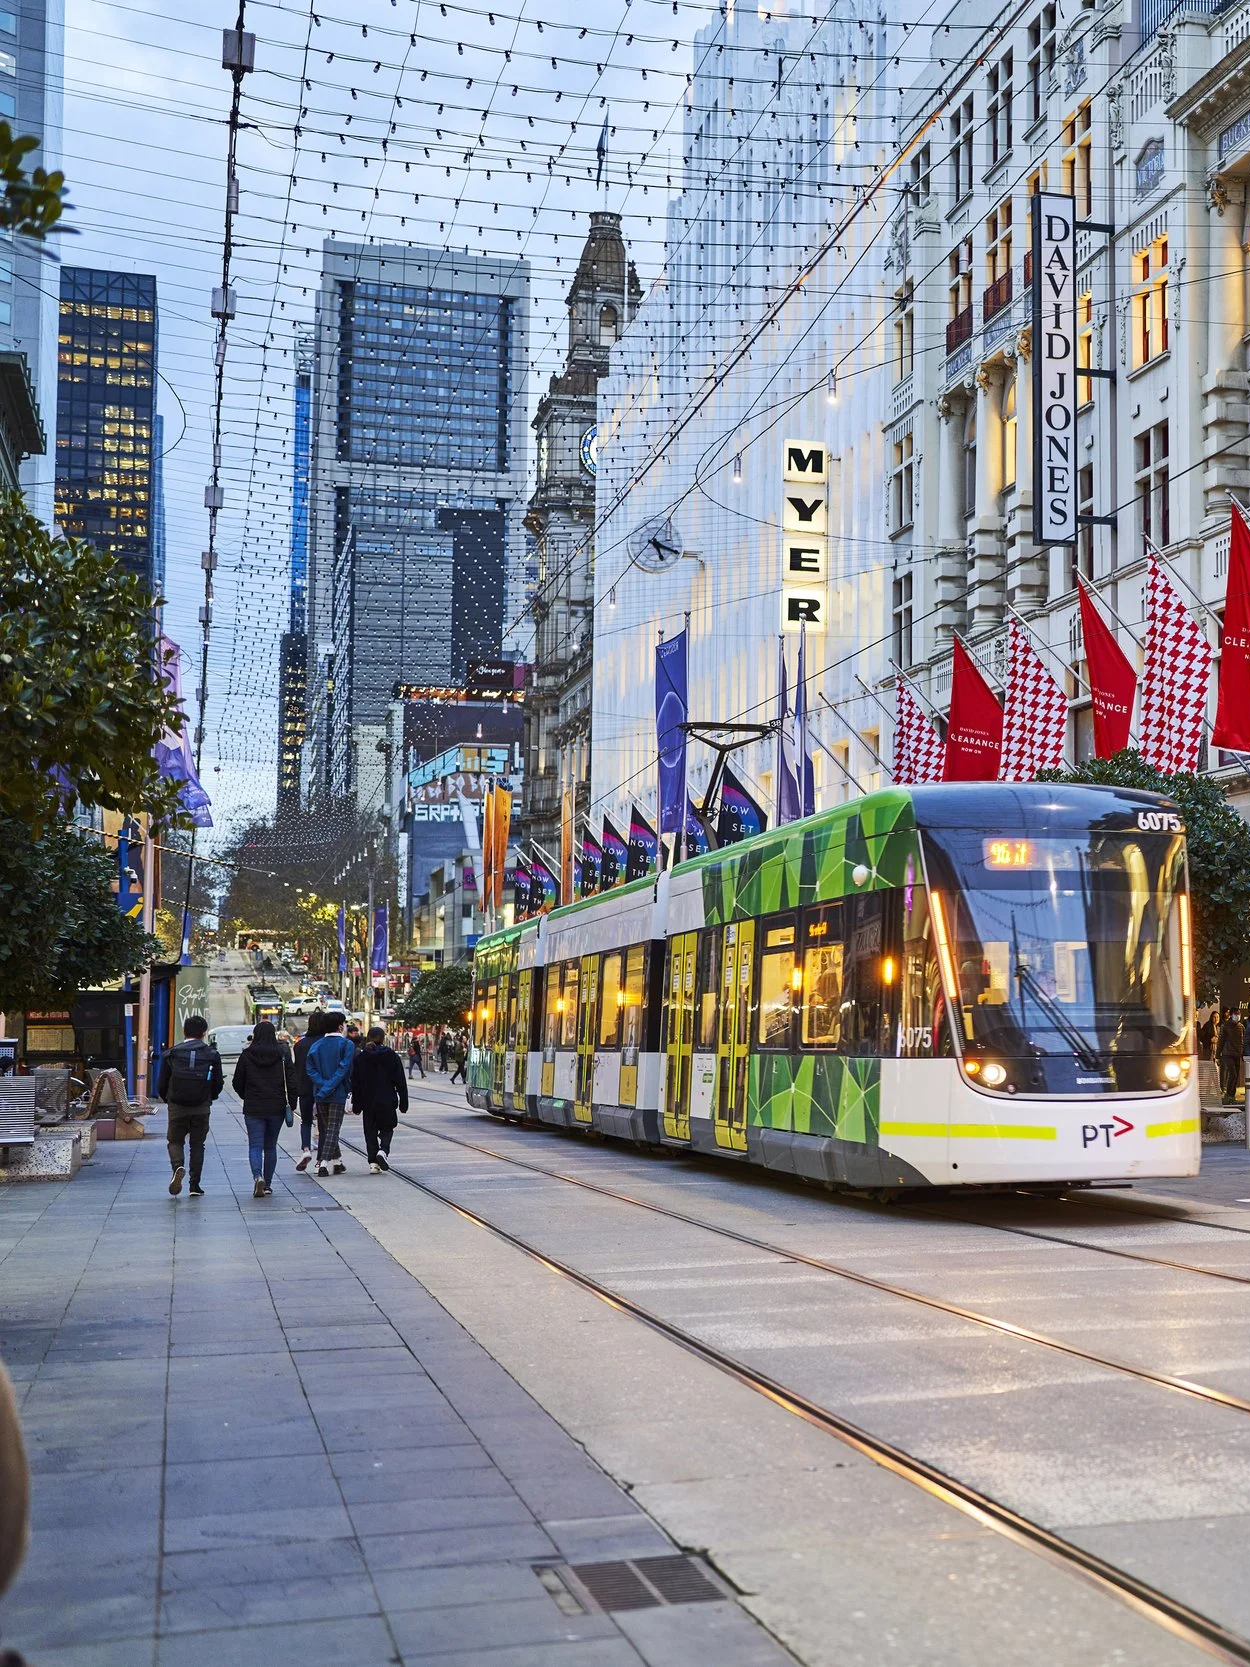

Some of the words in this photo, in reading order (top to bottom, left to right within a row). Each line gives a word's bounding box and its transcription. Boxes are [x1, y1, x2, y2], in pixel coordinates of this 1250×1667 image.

[1045, 215, 1071, 360] DAVID
[1045, 372, 1071, 525] JONES
[786, 447, 825, 622] MYER
[721, 804, 750, 815] NOW
[1137, 812, 1182, 832] 6075
[732, 823, 755, 833] SET
[630, 839, 655, 849] NOW
[688, 844, 709, 853] SET
[602, 847, 625, 856] NOW
[609, 862, 628, 871] SET
[532, 875, 550, 883] NOW
[603, 874, 621, 884] THE
